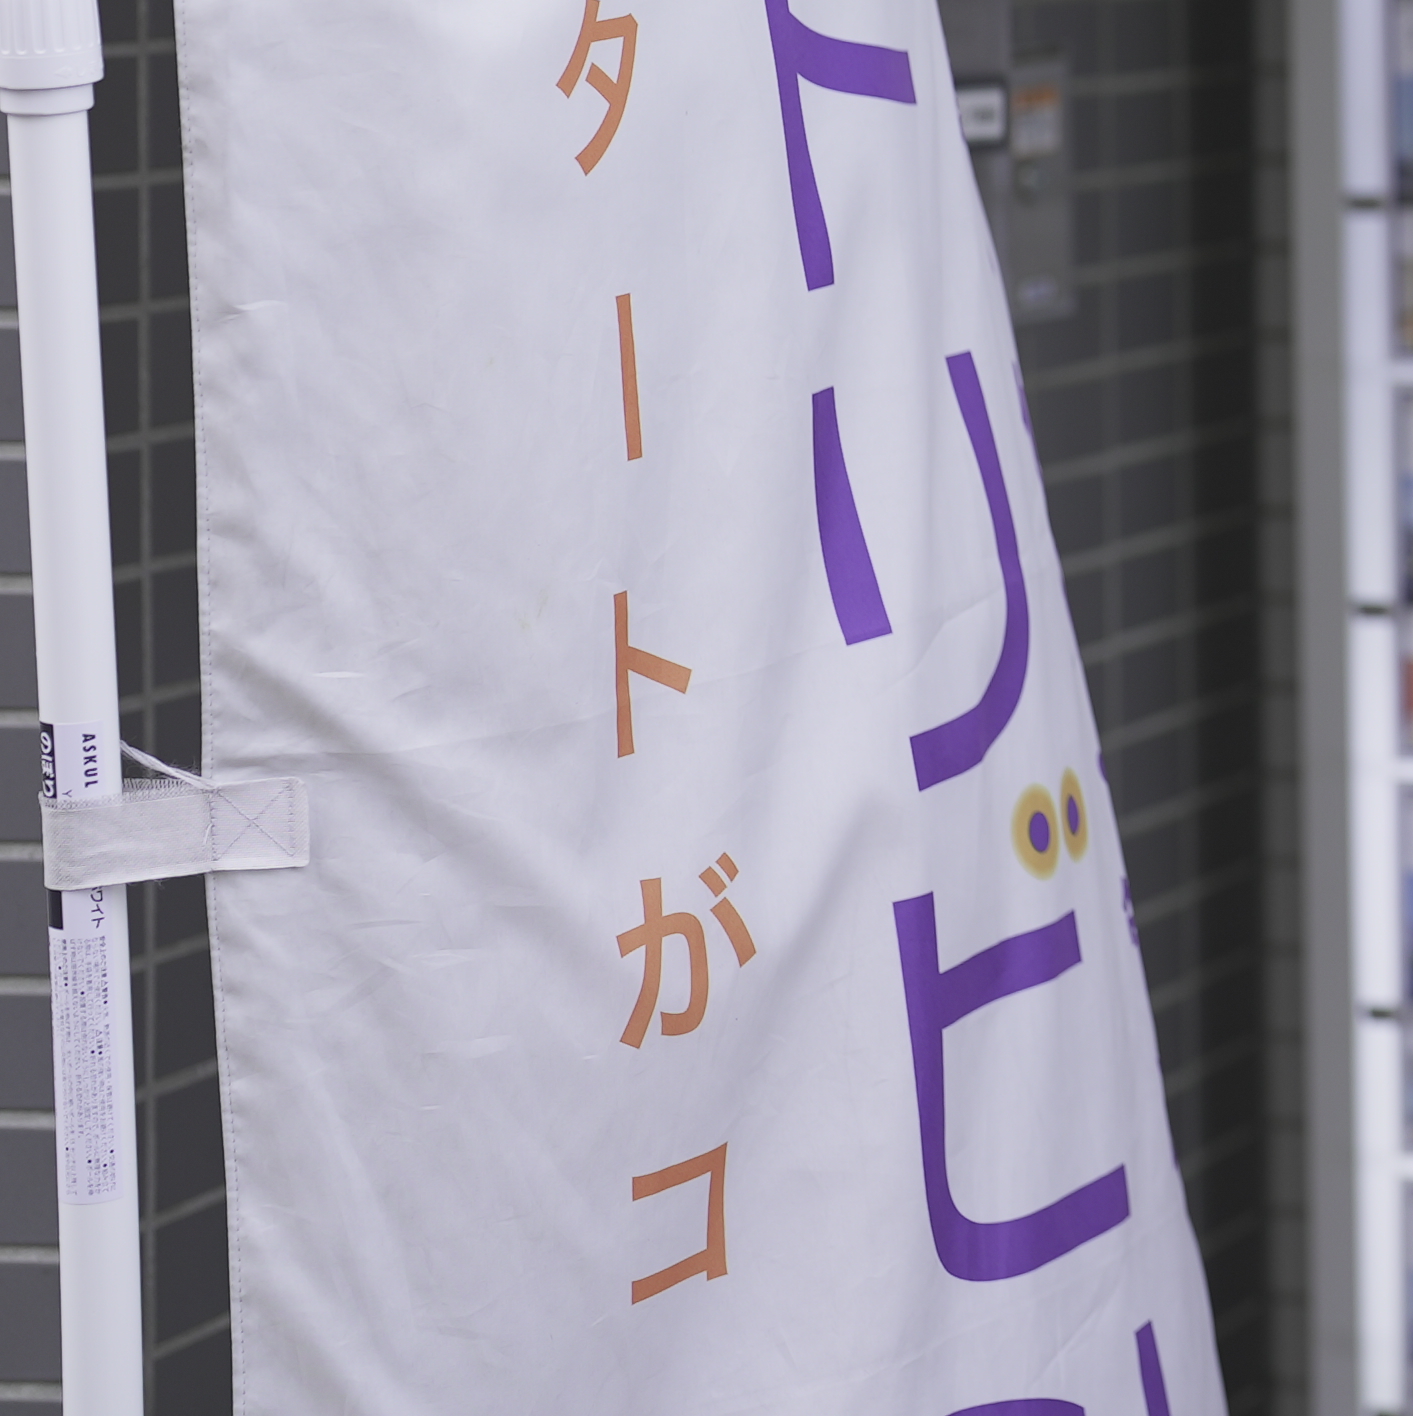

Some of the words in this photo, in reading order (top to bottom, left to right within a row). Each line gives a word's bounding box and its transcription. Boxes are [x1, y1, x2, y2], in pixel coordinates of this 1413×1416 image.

[82, 733, 99, 788] ASKUL
[90, 886, 105, 929] ワイト
